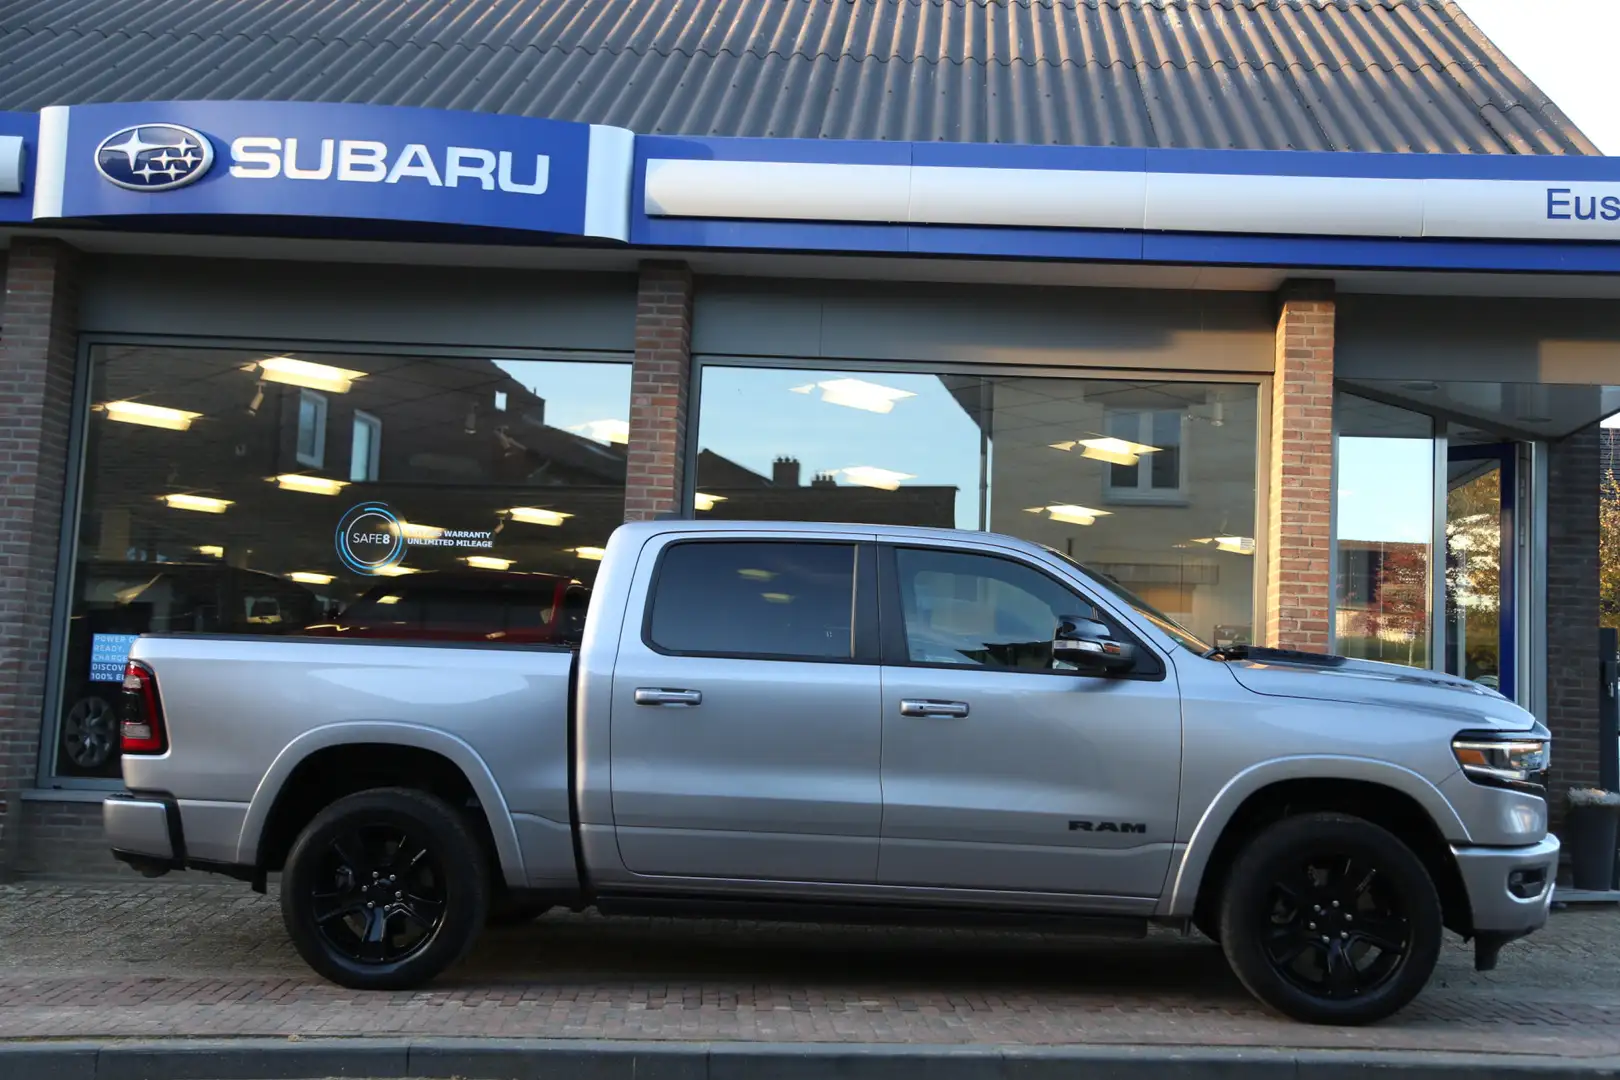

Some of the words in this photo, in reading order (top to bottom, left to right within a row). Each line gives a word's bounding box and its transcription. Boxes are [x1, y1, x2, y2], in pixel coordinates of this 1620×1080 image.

[229, 137, 550, 195] SUBARU
[1547, 188, 1620, 221] Eus
[352, 532, 391, 545] SAFE8
[444, 531, 491, 539] WARRANTY
[407, 538, 454, 547] UNLIMITED
[456, 540, 493, 548] MILEAGE
[1068, 820, 1147, 833] RAM
